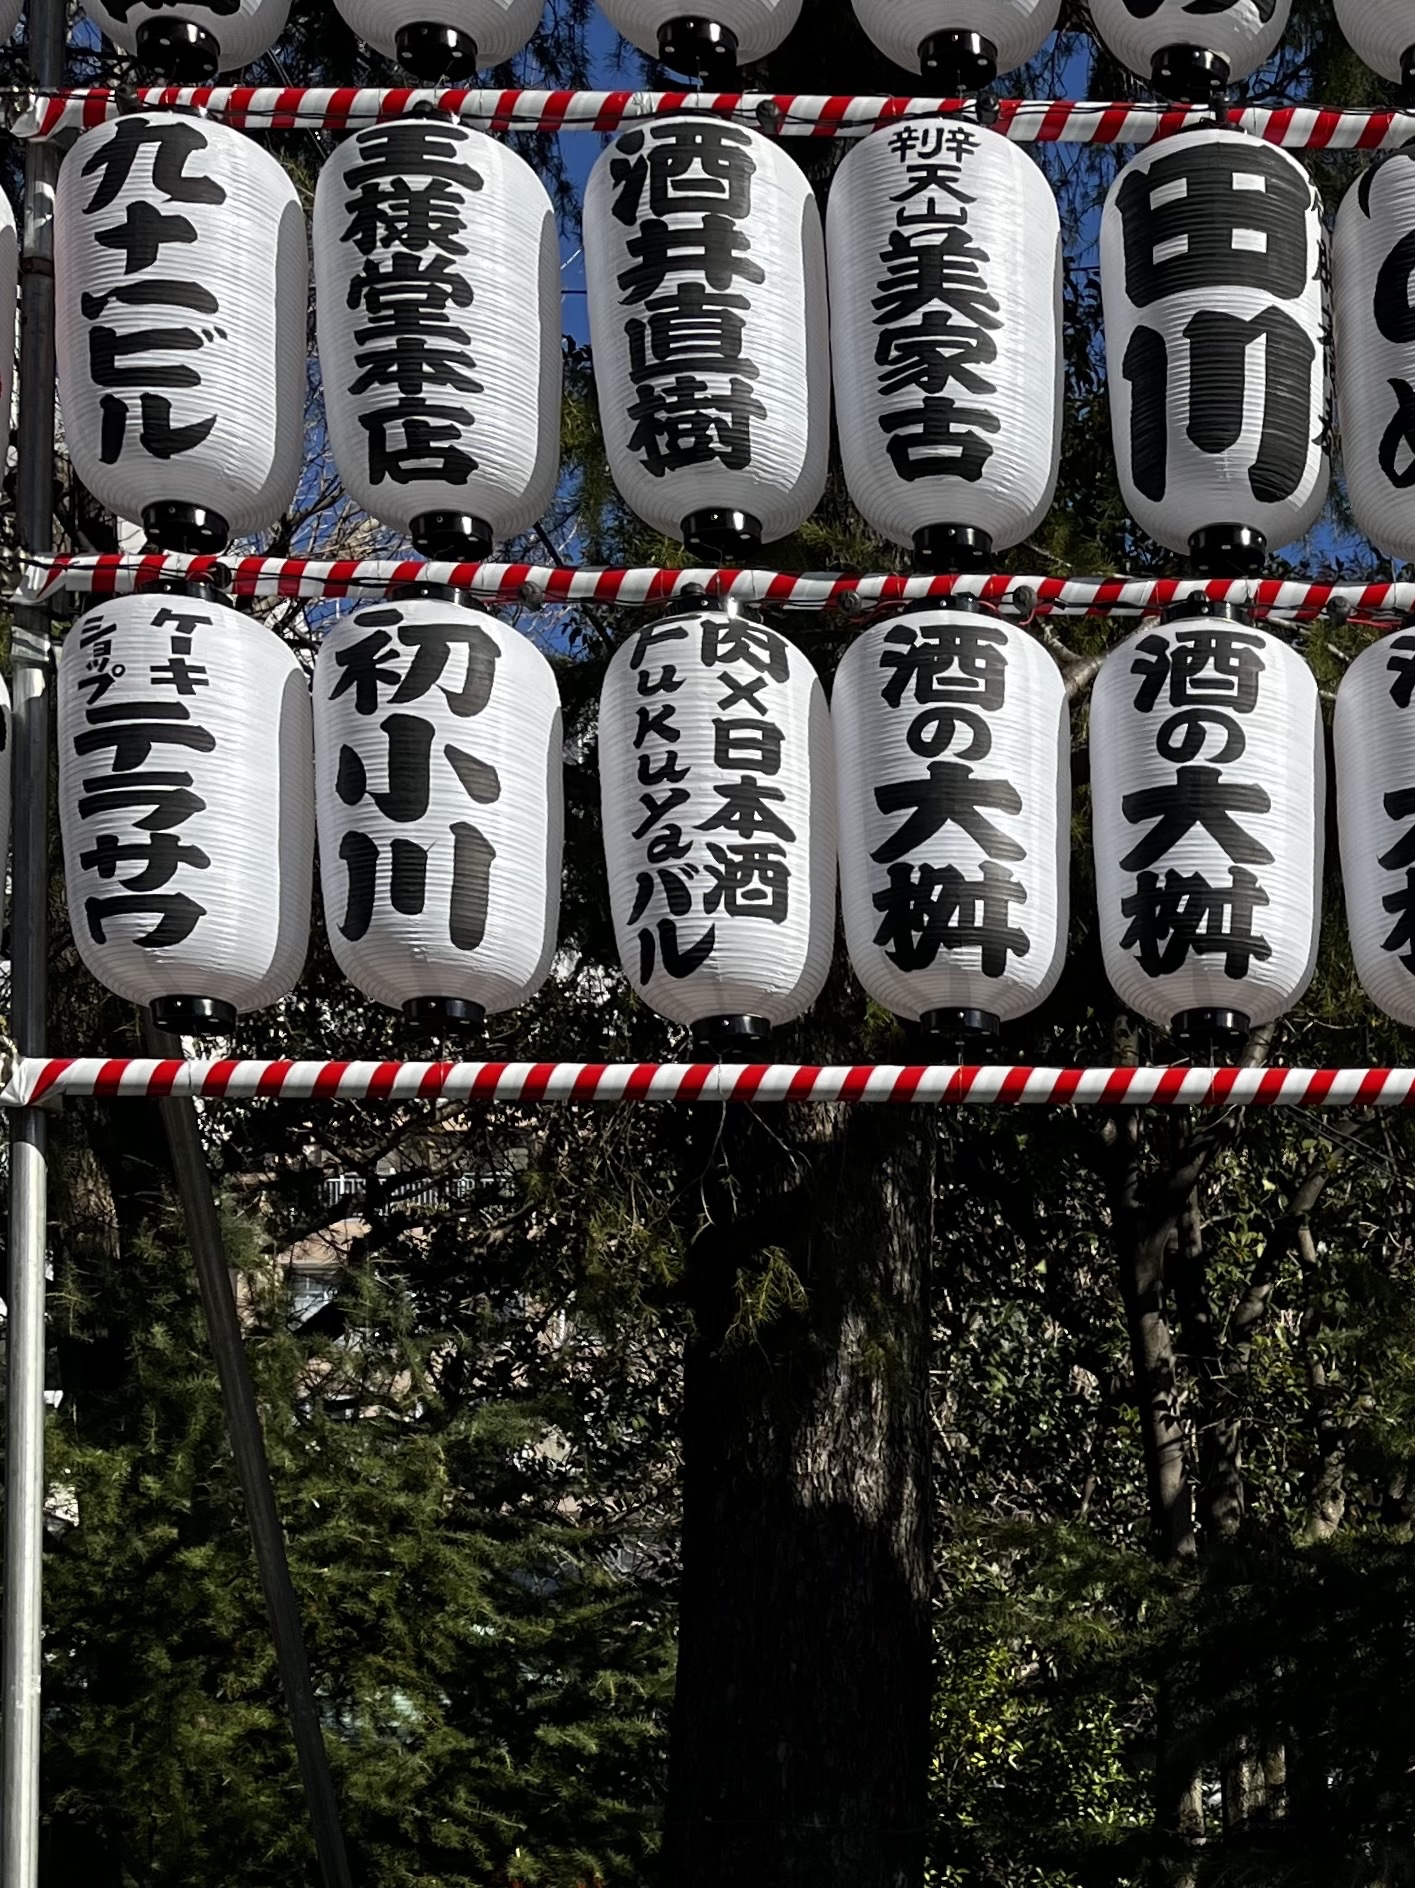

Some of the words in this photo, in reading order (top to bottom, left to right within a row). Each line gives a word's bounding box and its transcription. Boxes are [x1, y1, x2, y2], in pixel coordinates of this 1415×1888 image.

[339, 123, 484, 486] 王様堂本店
[608, 121, 768, 478] 酒井直樹
[1115, 142, 1316, 503] 田川
[73, 701, 217, 949] テラサワ
[78, 614, 126, 705] ショップ
[150, 607, 214, 695] ケーキ
[329, 608, 502, 951] 初小川
[868, 623, 1031, 979] 酒の大桝
[1117, 629, 1277, 980] 酒の大桝
